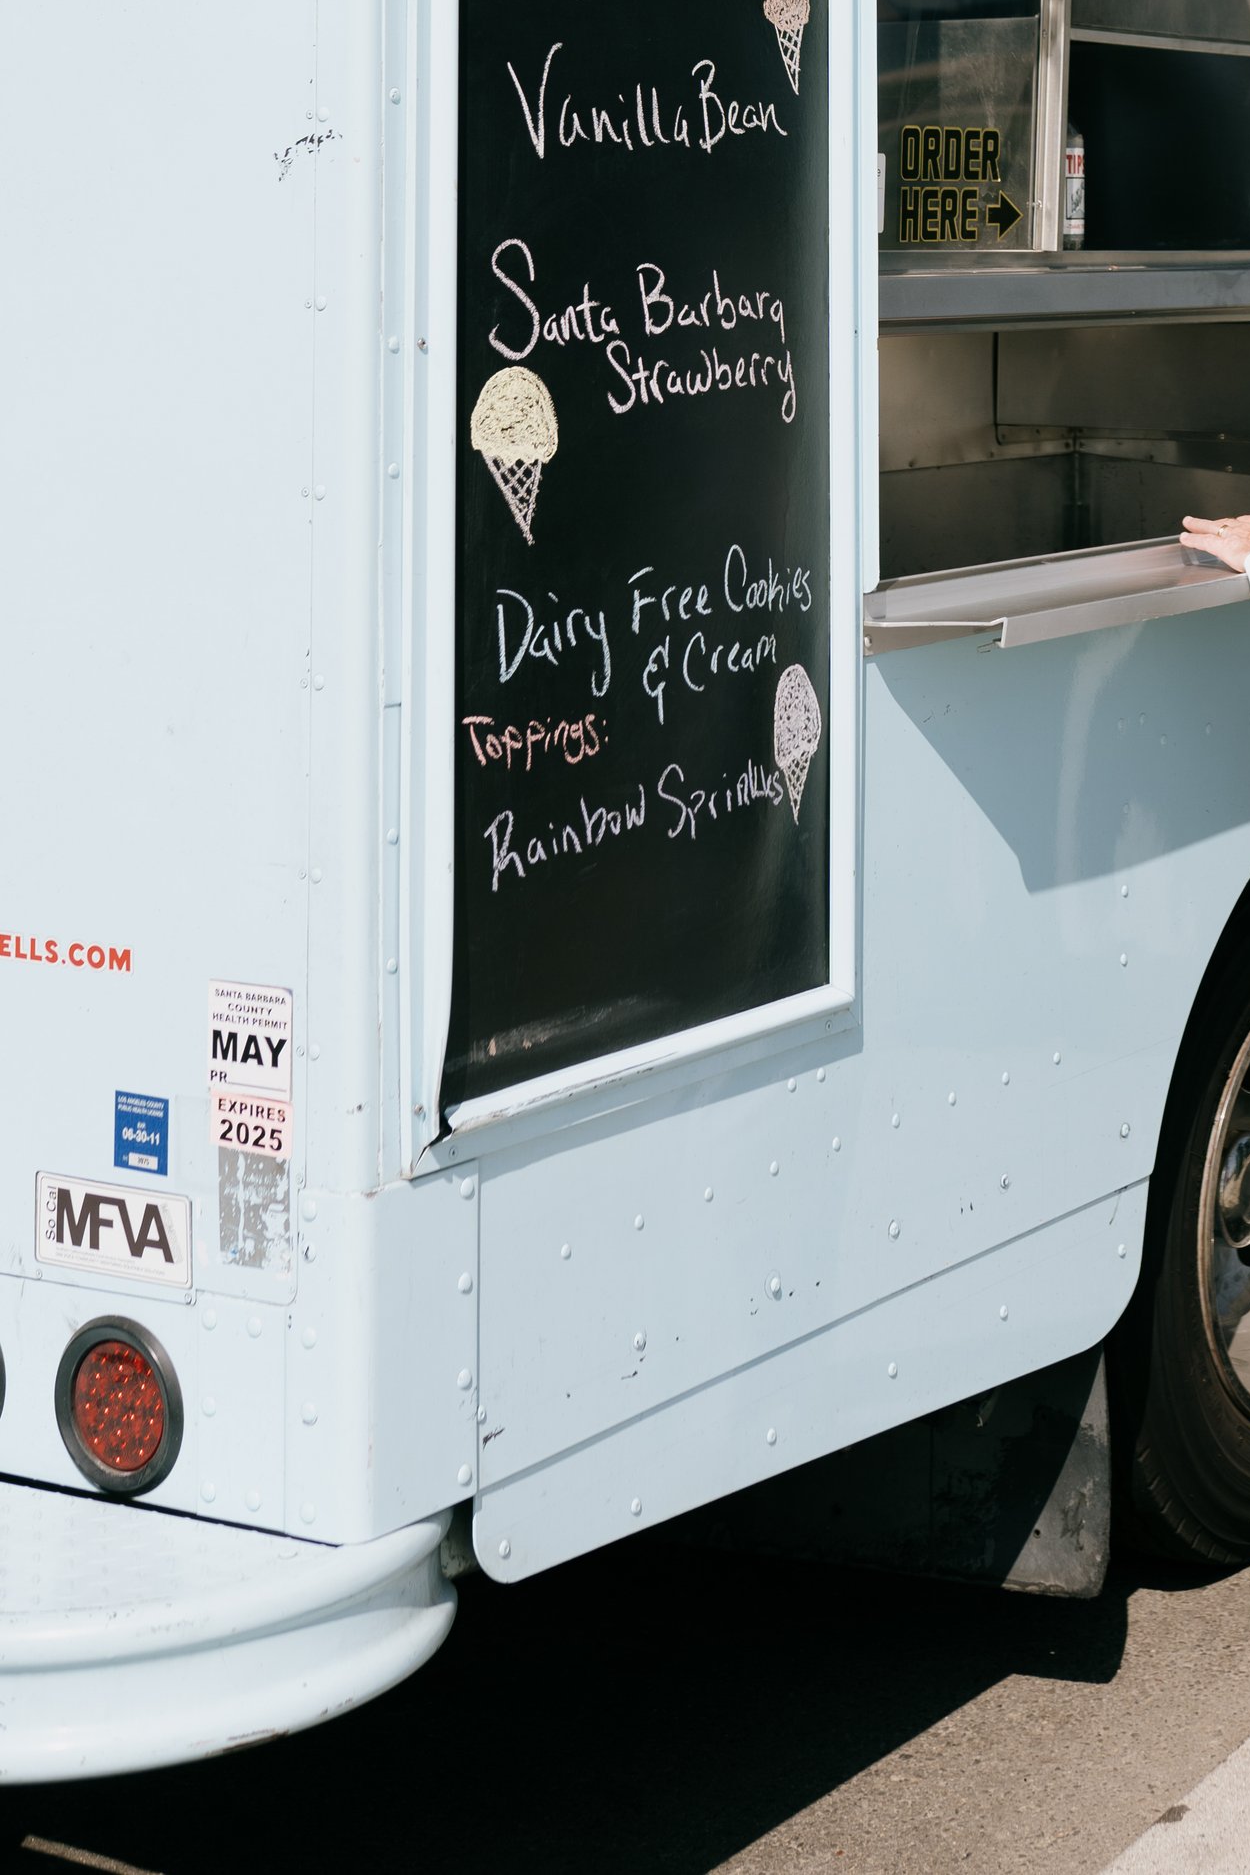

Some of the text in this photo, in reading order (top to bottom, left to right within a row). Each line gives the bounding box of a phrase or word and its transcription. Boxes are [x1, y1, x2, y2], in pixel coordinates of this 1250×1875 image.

[507, 43, 788, 159] Vanilla Bean
[901, 125, 1001, 182] ORDER
[900, 187, 979, 242] HERE
[489, 239, 786, 360] Santa Barbara
[606, 339, 797, 423] Strawberry
[497, 544, 813, 698] Dairy Free Cookies
[683, 631, 777, 692] Cream
[462, 714, 609, 771] Toppings:
[484, 784, 646, 892] Rainbow
[0, 934, 131, 972] ELLS.COM
[212, 1012, 288, 1030] HEALTH PERMIT
[215, 988, 287, 1005] SANTA BARBARA
[228, 1003, 272, 1016] COUNTY
[212, 1029, 287, 1068] MAY
[122, 1127, 160, 1146] 06-30-11
[218, 1098, 286, 1123] EXPIRES
[220, 1119, 282, 1151] 2025
[45, 1186, 57, 1241] So Cal
[56, 1187, 175, 1264] MFVA
